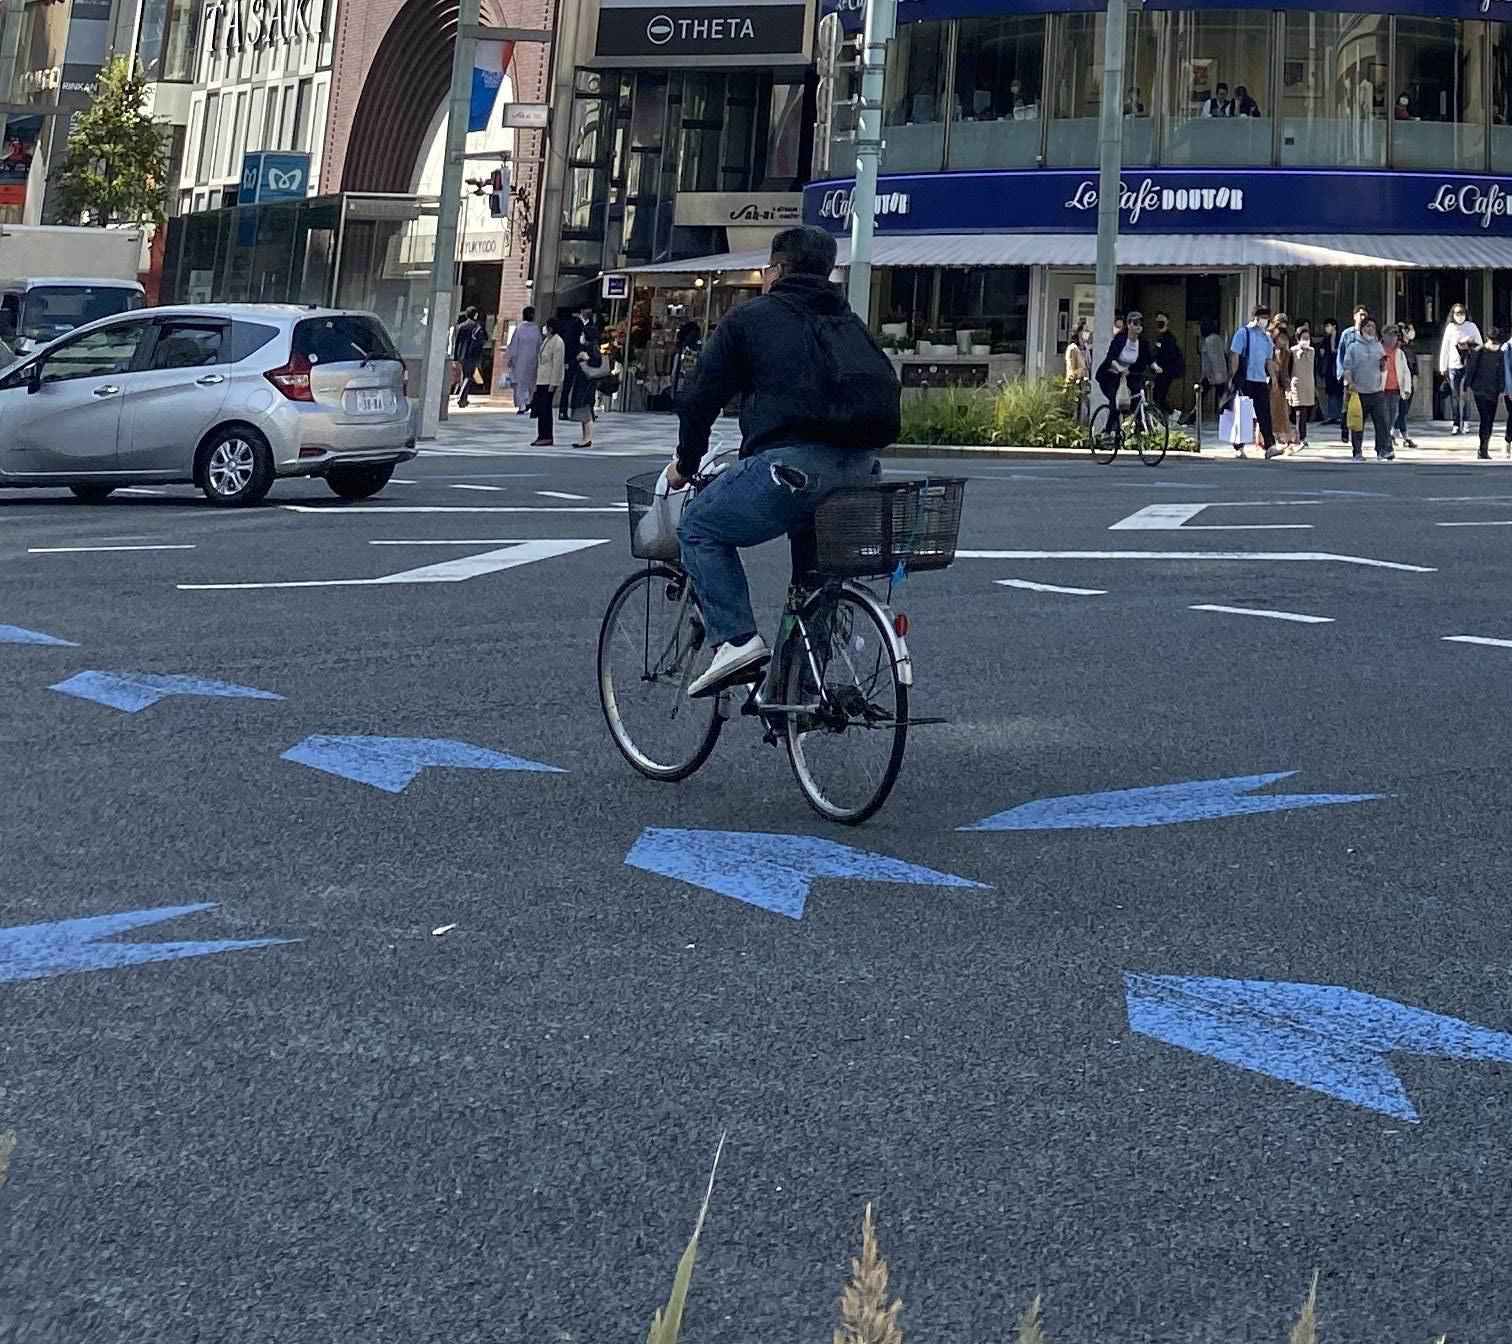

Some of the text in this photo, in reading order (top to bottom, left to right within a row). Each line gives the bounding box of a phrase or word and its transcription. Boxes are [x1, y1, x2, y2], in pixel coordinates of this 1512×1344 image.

[678, 18, 755, 40] THETA
[832, 186, 859, 230] Caf
[873, 191, 908, 214] UTOR
[1066, 178, 1243, 224] Le afé DOUTOR
[1427, 184, 1458, 213] Le
[1458, 184, 1506, 228] Café
